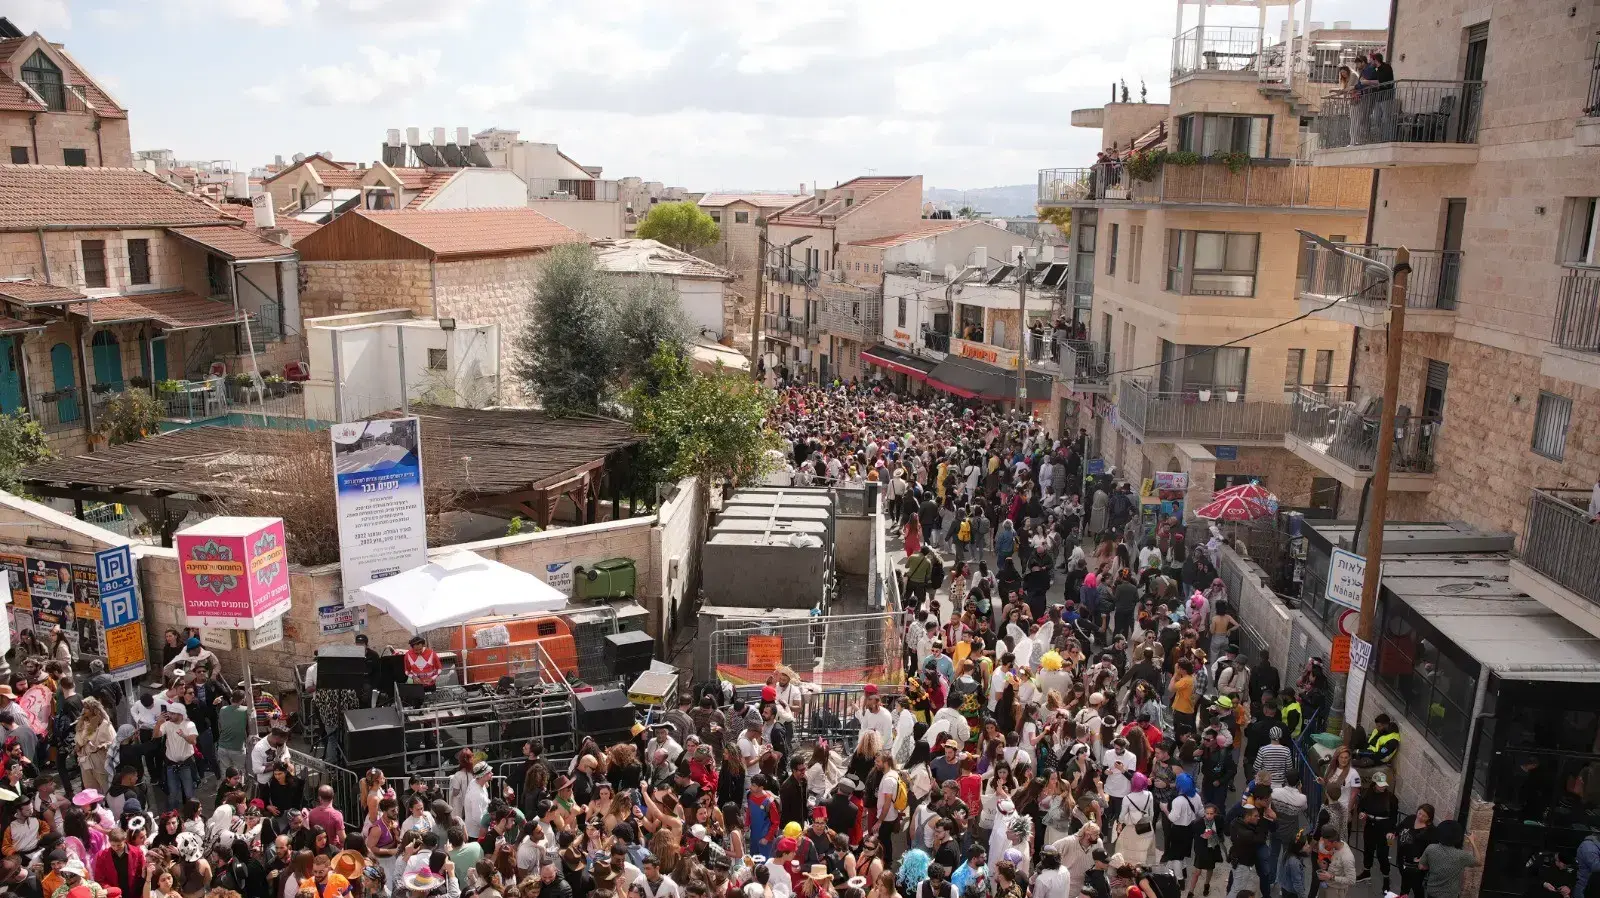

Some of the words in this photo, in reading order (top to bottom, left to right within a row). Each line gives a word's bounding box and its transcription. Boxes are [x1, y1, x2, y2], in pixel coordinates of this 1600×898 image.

[361, 483, 376, 492] בכר
[378, 480, 399, 491] ניסים
[189, 599, 220, 607] להתאהב
